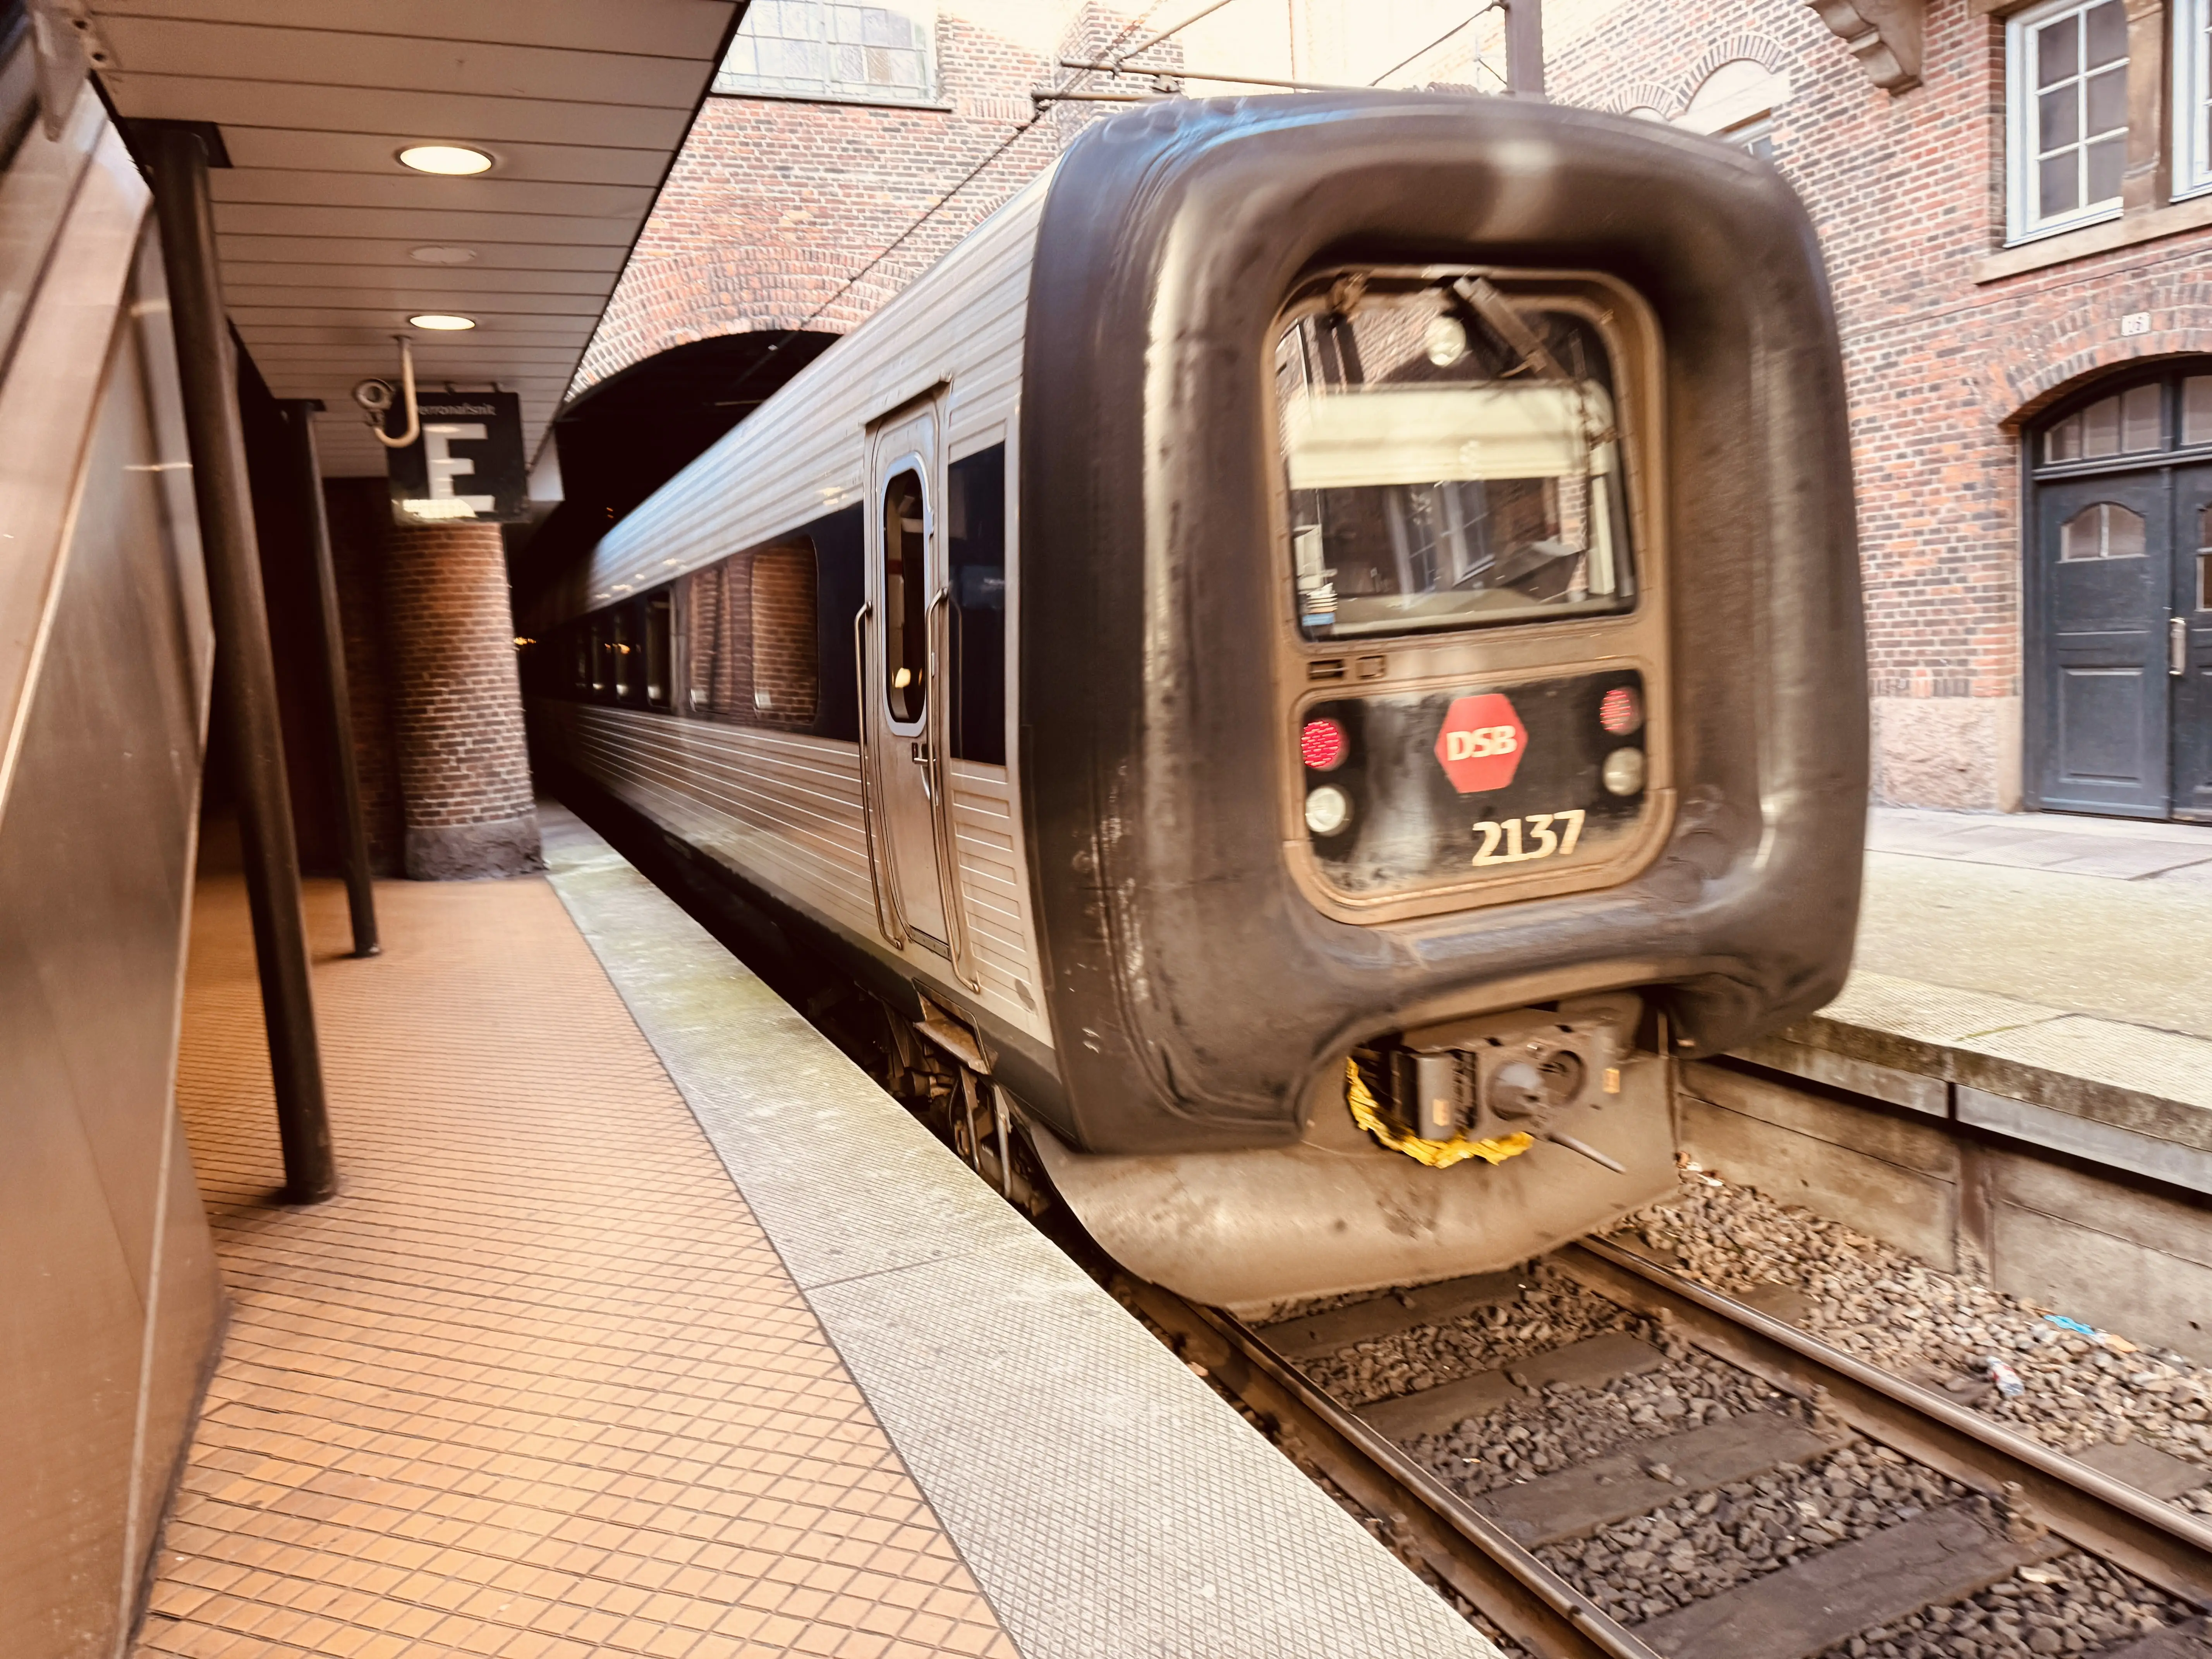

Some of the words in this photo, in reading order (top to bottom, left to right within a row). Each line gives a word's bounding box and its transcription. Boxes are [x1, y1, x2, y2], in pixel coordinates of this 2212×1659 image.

[422, 423, 495, 512] E
[1446, 725, 1518, 761] DSB
[1472, 809, 1585, 867] 2137
